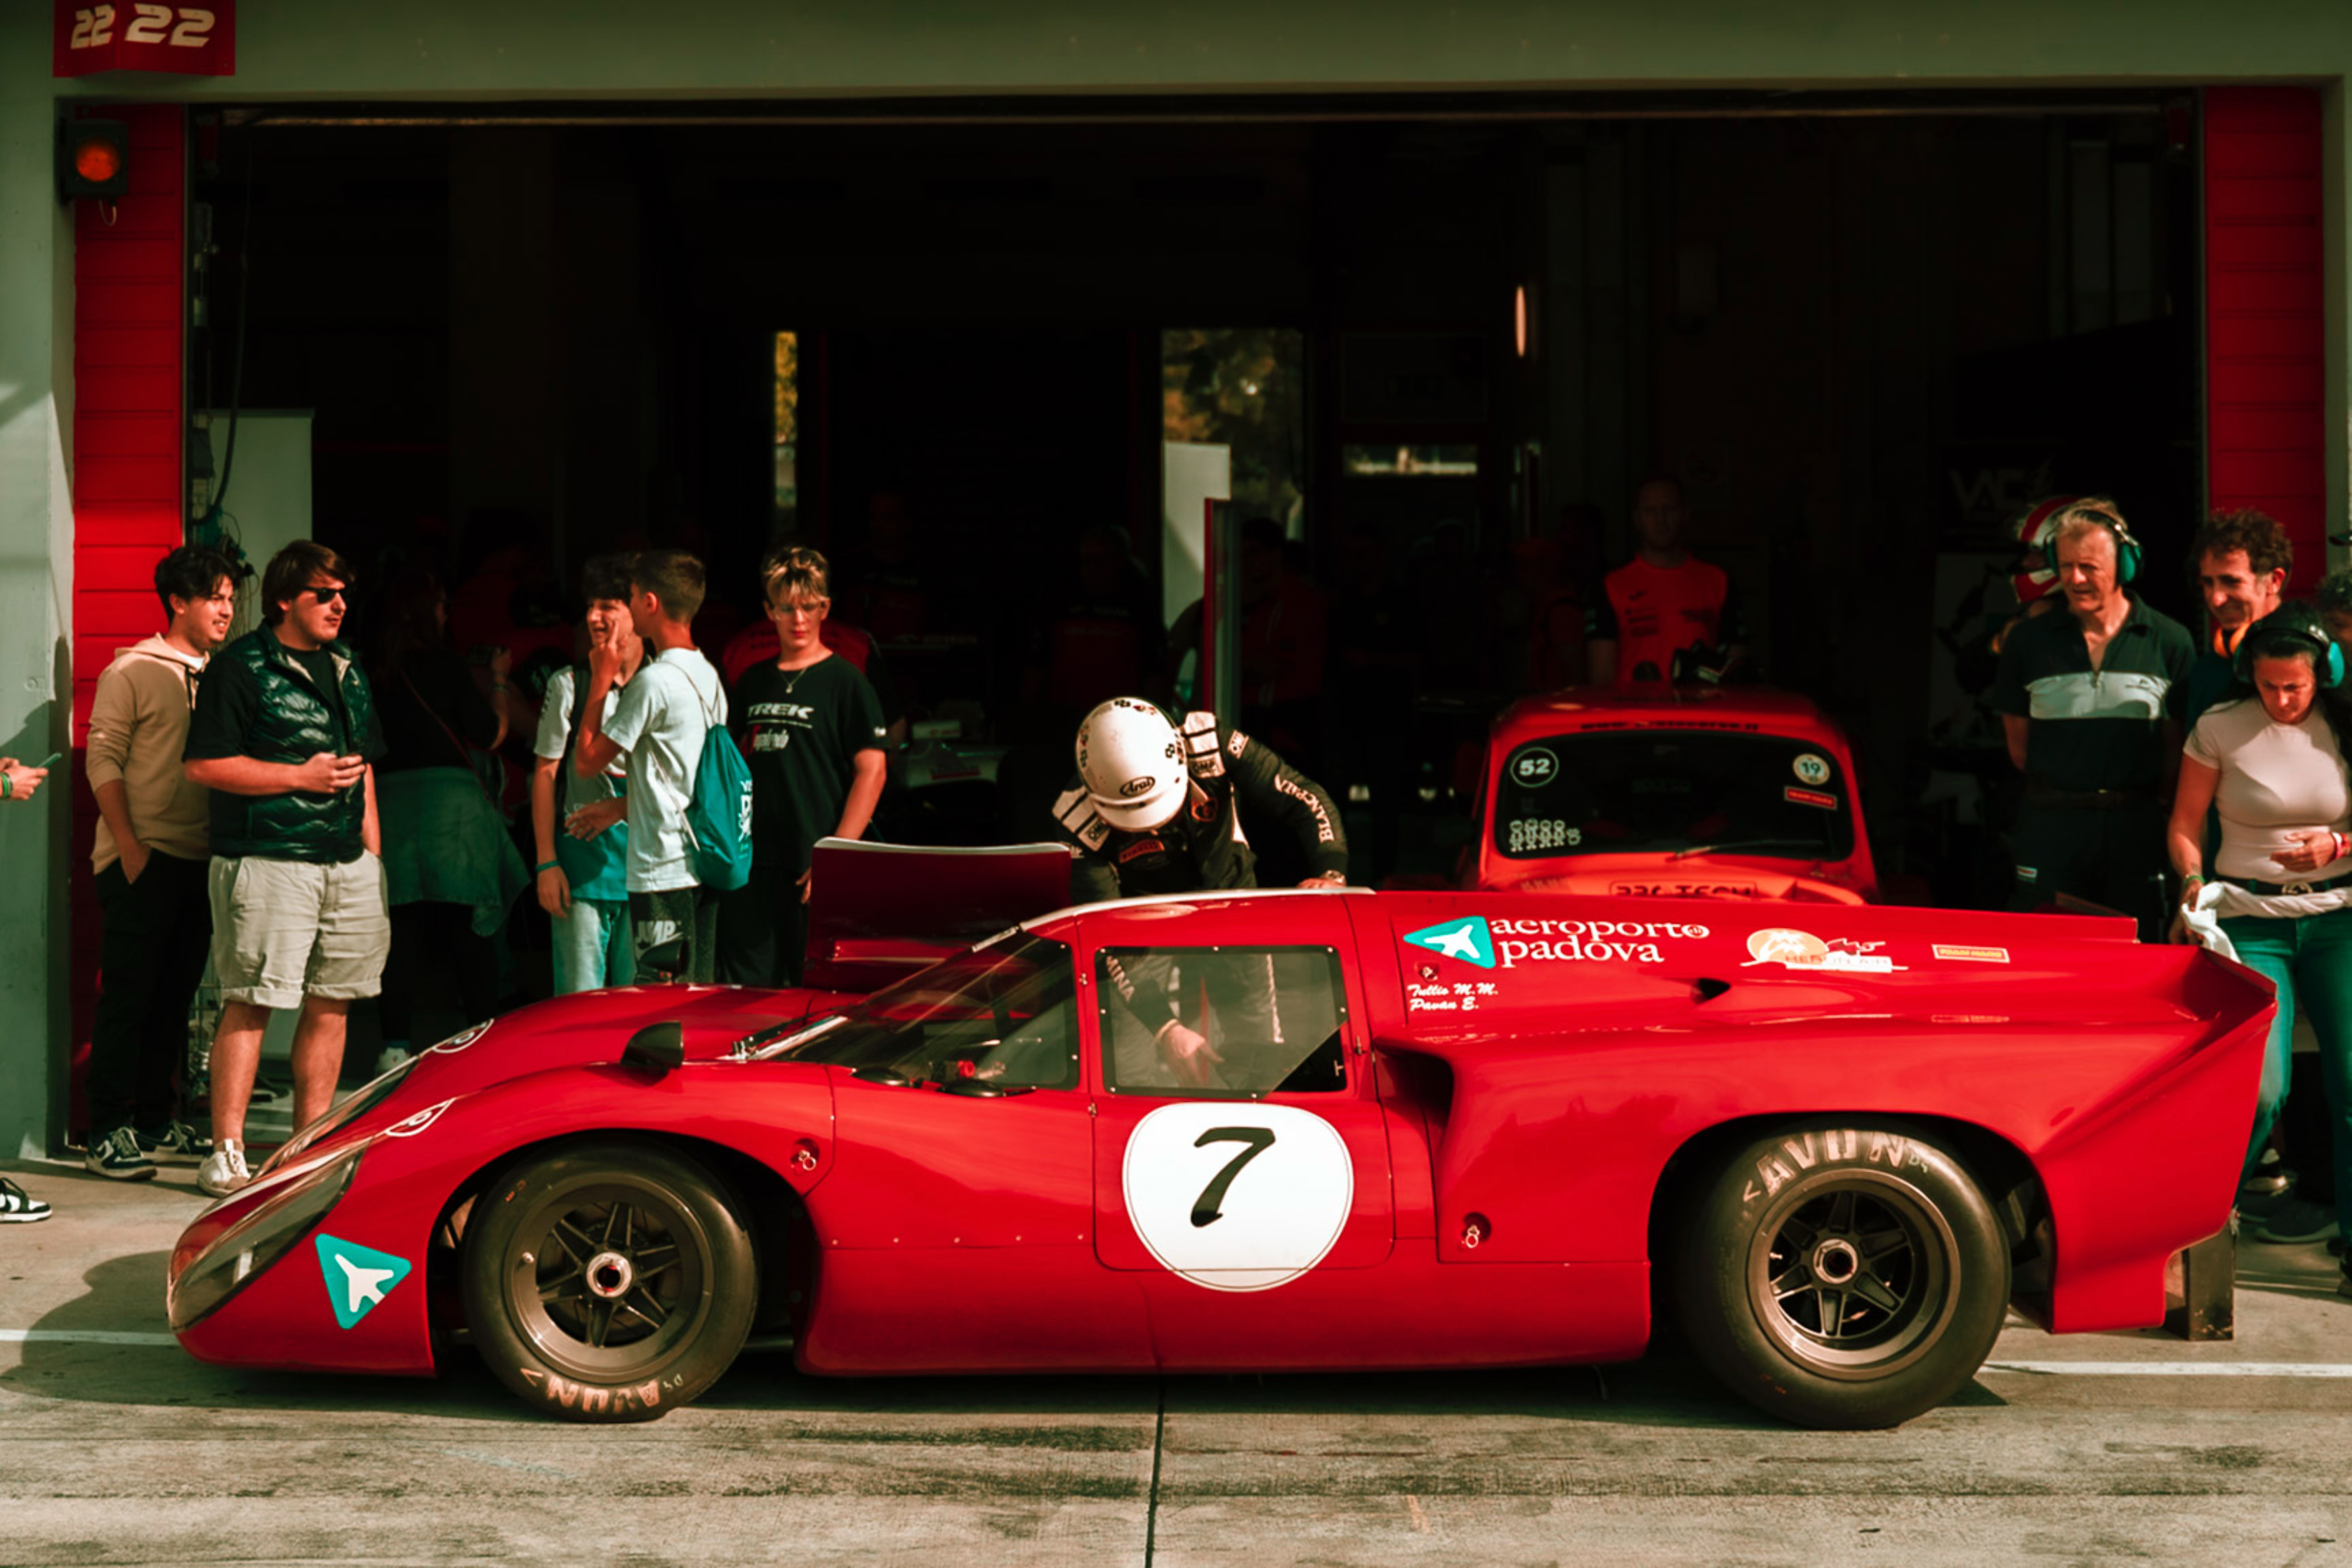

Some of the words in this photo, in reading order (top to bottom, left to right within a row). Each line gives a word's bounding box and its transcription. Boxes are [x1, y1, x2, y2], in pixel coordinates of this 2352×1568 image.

[71, 4, 116, 49] 22
[124, 3, 216, 47] 22
[748, 703, 814, 720] TREK
[1192, 759, 1217, 773] OMP
[1518, 759, 1552, 776] 52
[1801, 762, 1821, 775] 19
[1125, 778, 1152, 794] Arai
[1274, 773, 1335, 843] BLANCPAIN
[1491, 919, 1710, 942] aeroporto
[1499, 935, 1665, 968] padova
[1407, 983, 1450, 997] Tullio
[1410, 997, 1458, 1012] Pavan
[1461, 996, 1479, 1011] E.
[1755, 1129, 1907, 1198] AVON
[1190, 1126, 1276, 1228] 7
[547, 1379, 661, 1415] AVON
